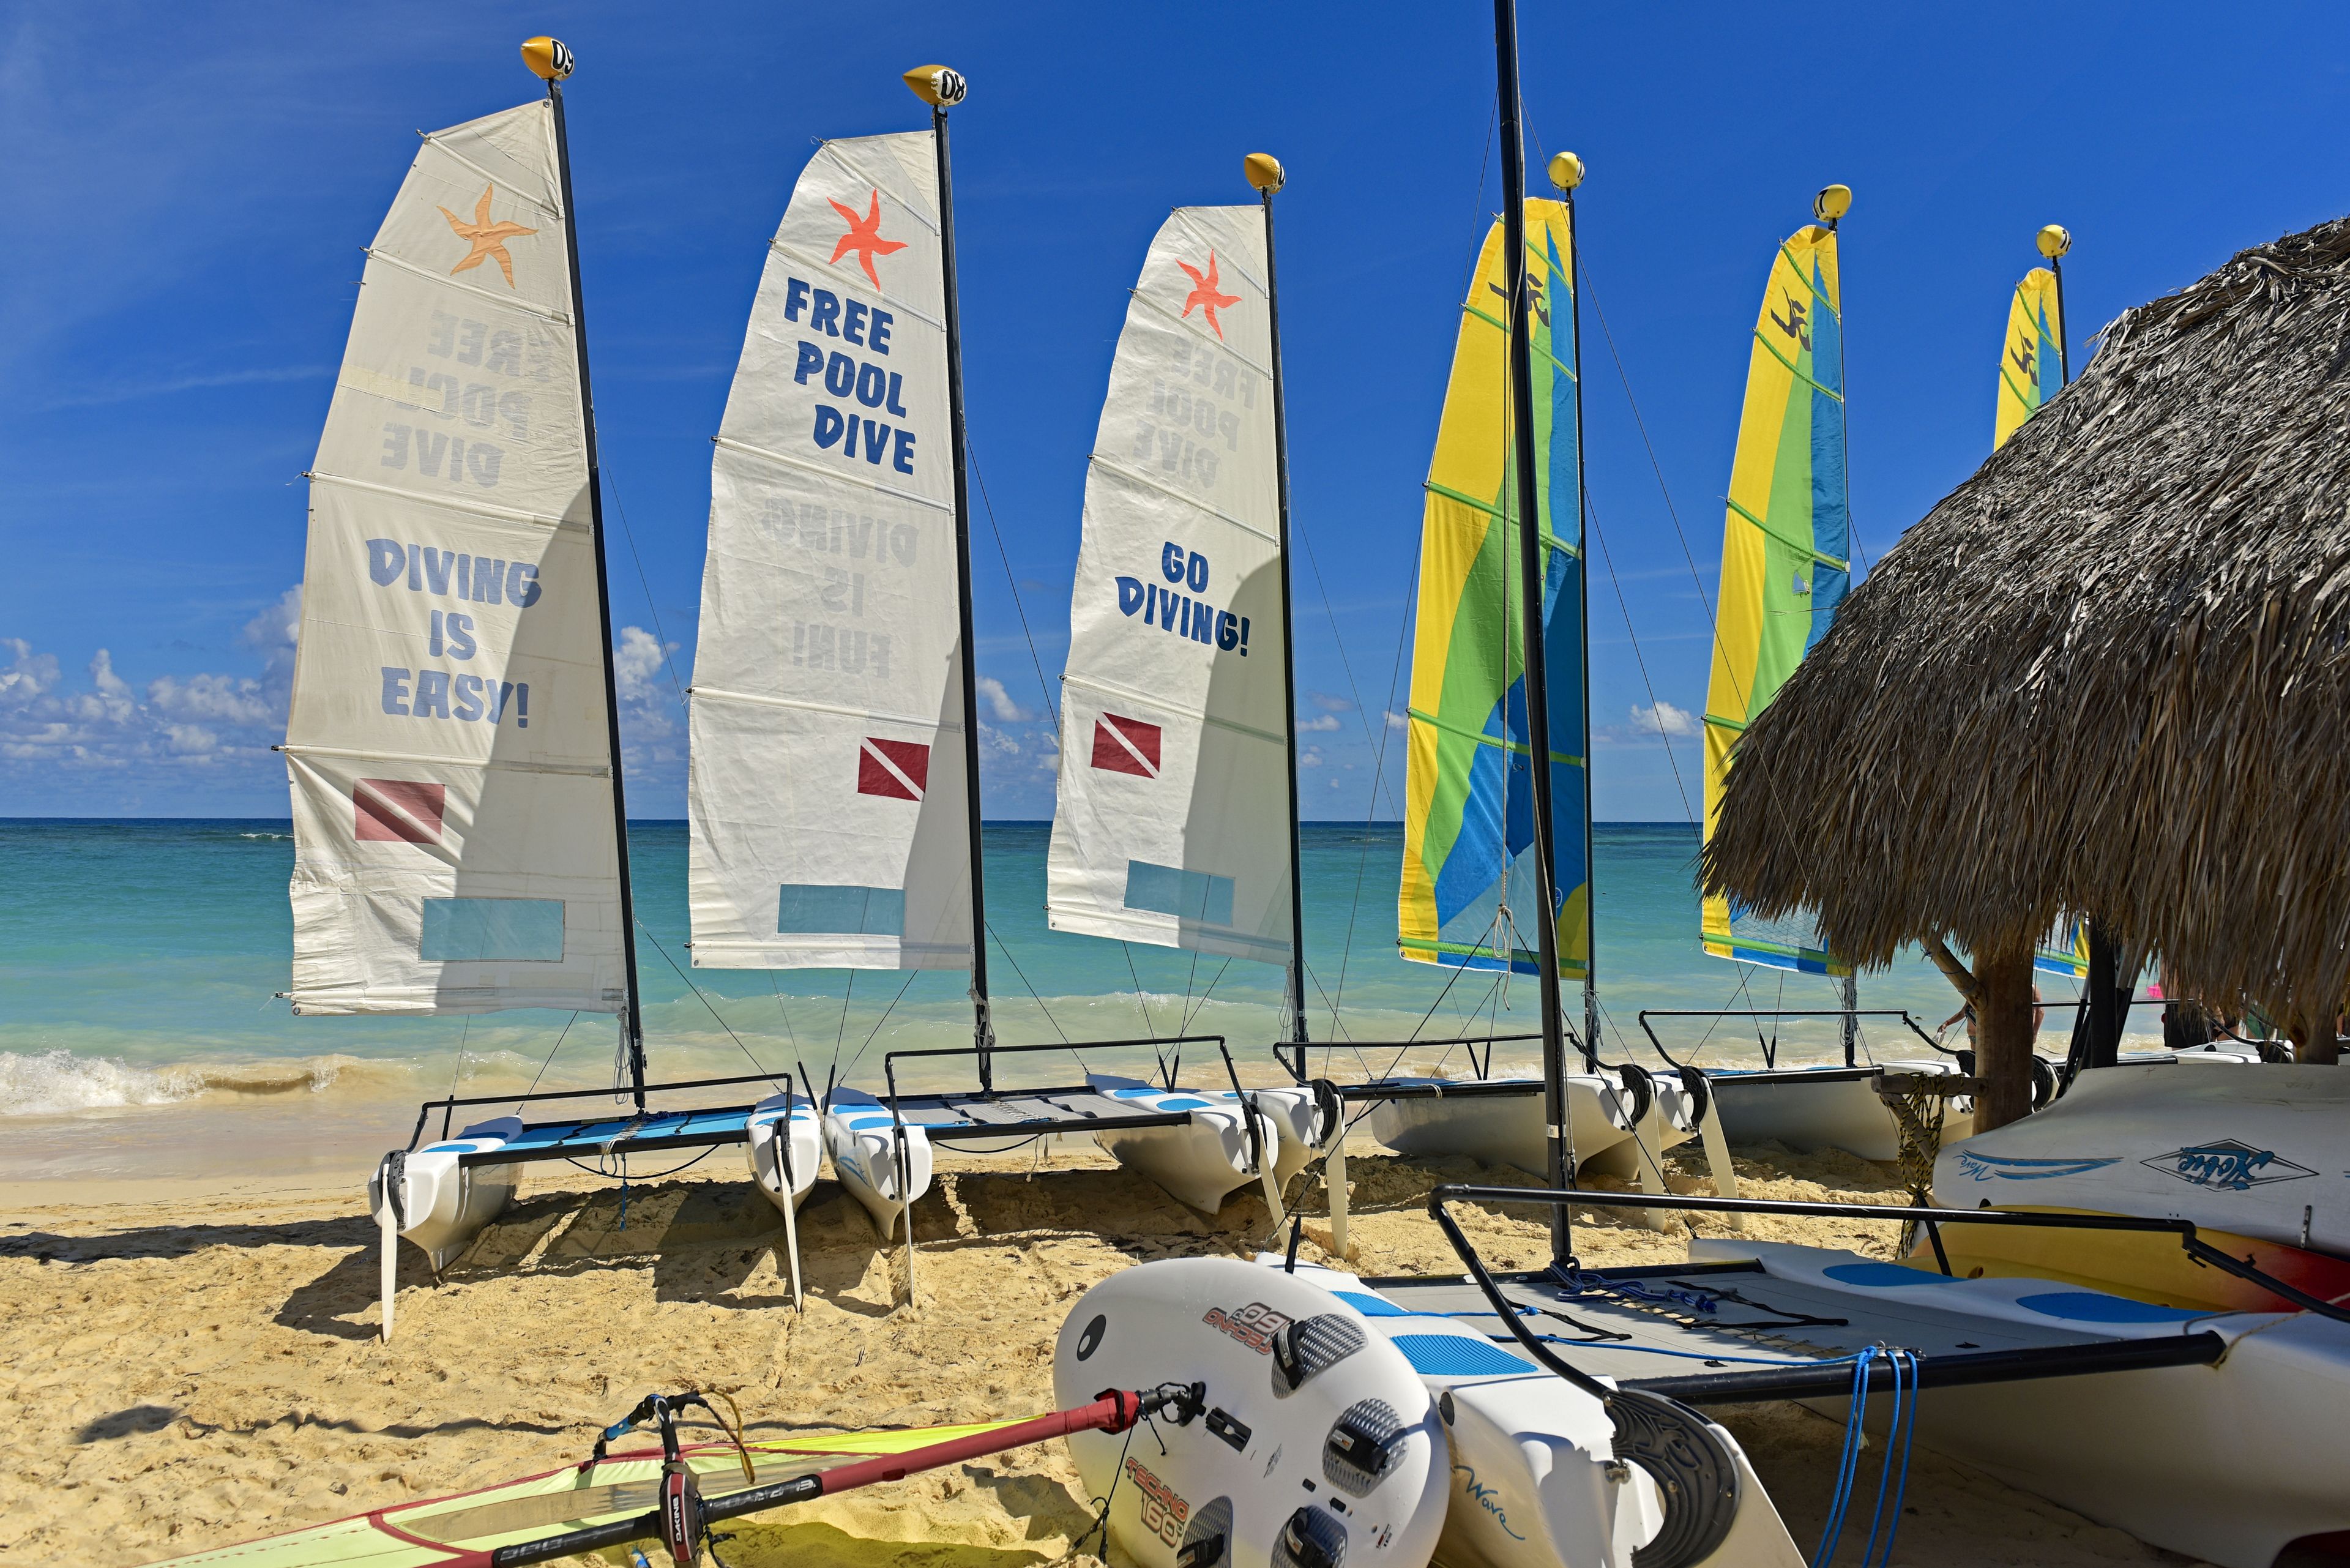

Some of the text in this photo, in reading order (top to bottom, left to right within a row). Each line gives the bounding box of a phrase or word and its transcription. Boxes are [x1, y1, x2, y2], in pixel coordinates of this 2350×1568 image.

[551, 40, 574, 75] D9
[941, 70, 965, 102] D8
[784, 277, 893, 356] FREE
[794, 340, 906, 419] POOL
[813, 405, 916, 476] DIVE
[365, 538, 542, 608] DIVING
[1162, 541, 1209, 593] GO
[429, 609, 477, 661] IS
[1115, 576, 1250, 657] DIVING!
[381, 666, 529, 728] EASY!
[1952, 1154, 1994, 1182] Wave
[673, 1495, 682, 1542] DAKINE
[1125, 1456, 1190, 1523] TECHNO
[1453, 1465, 1526, 1540] Wave
